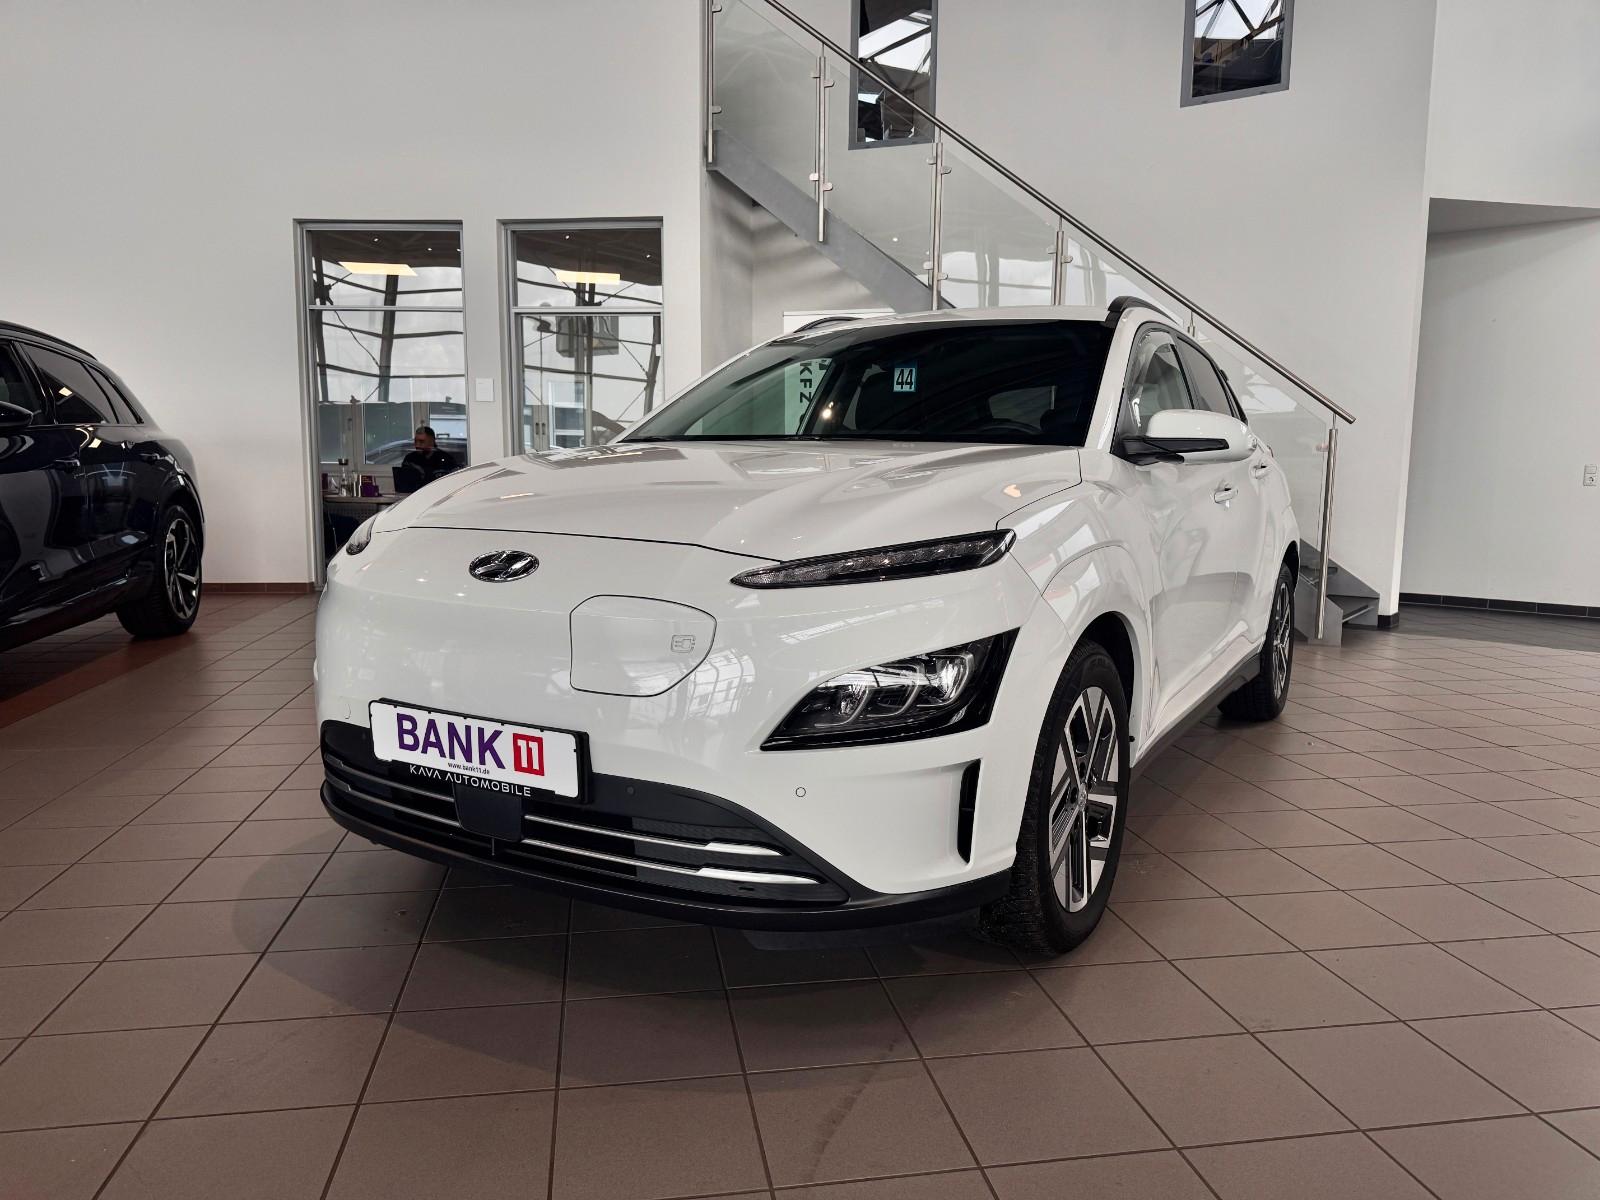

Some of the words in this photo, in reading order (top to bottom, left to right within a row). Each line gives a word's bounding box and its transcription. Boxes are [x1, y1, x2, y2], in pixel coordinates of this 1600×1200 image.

[895, 368, 914, 390] 44
[396, 713, 506, 770] BANK
[516, 737, 542, 772] 11
[409, 764, 442, 781] KAVA
[445, 774, 532, 797] AUTOMOBILE
[447, 761, 491, 776] www.bank11.de
